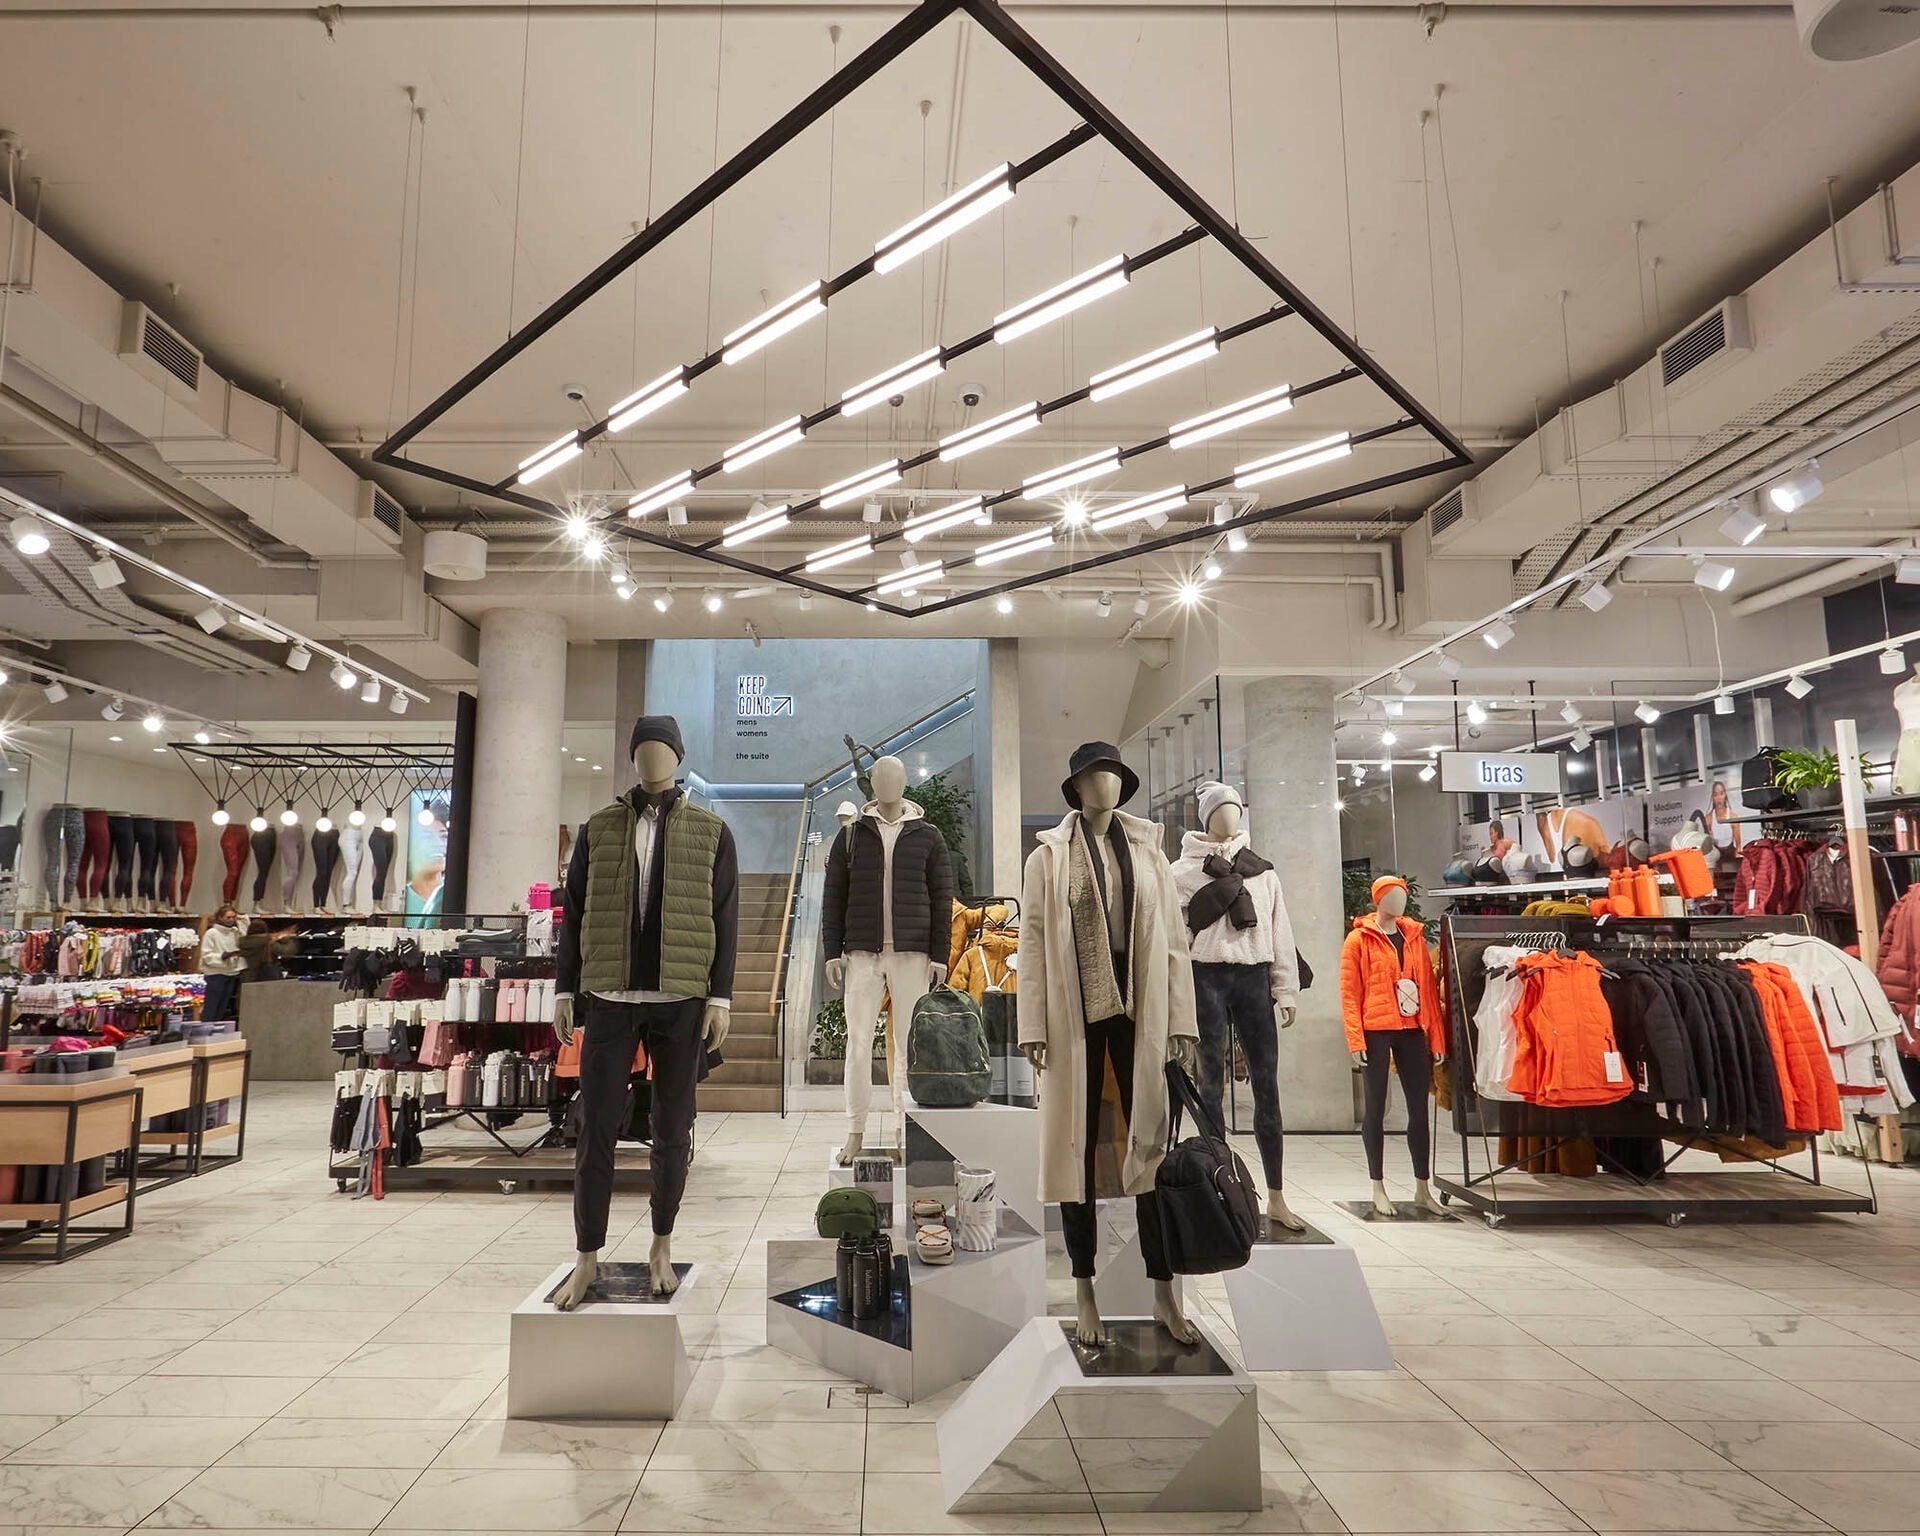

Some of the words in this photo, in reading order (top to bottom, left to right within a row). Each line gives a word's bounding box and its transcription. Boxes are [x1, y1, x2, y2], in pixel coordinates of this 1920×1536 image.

[739, 676, 765, 695] KEEP
[738, 696, 770, 715] GOING
[736, 752, 749, 760] the
[750, 752, 770, 760] suite
[1482, 760, 1523, 783] bras
[1654, 813, 1684, 826] Support
